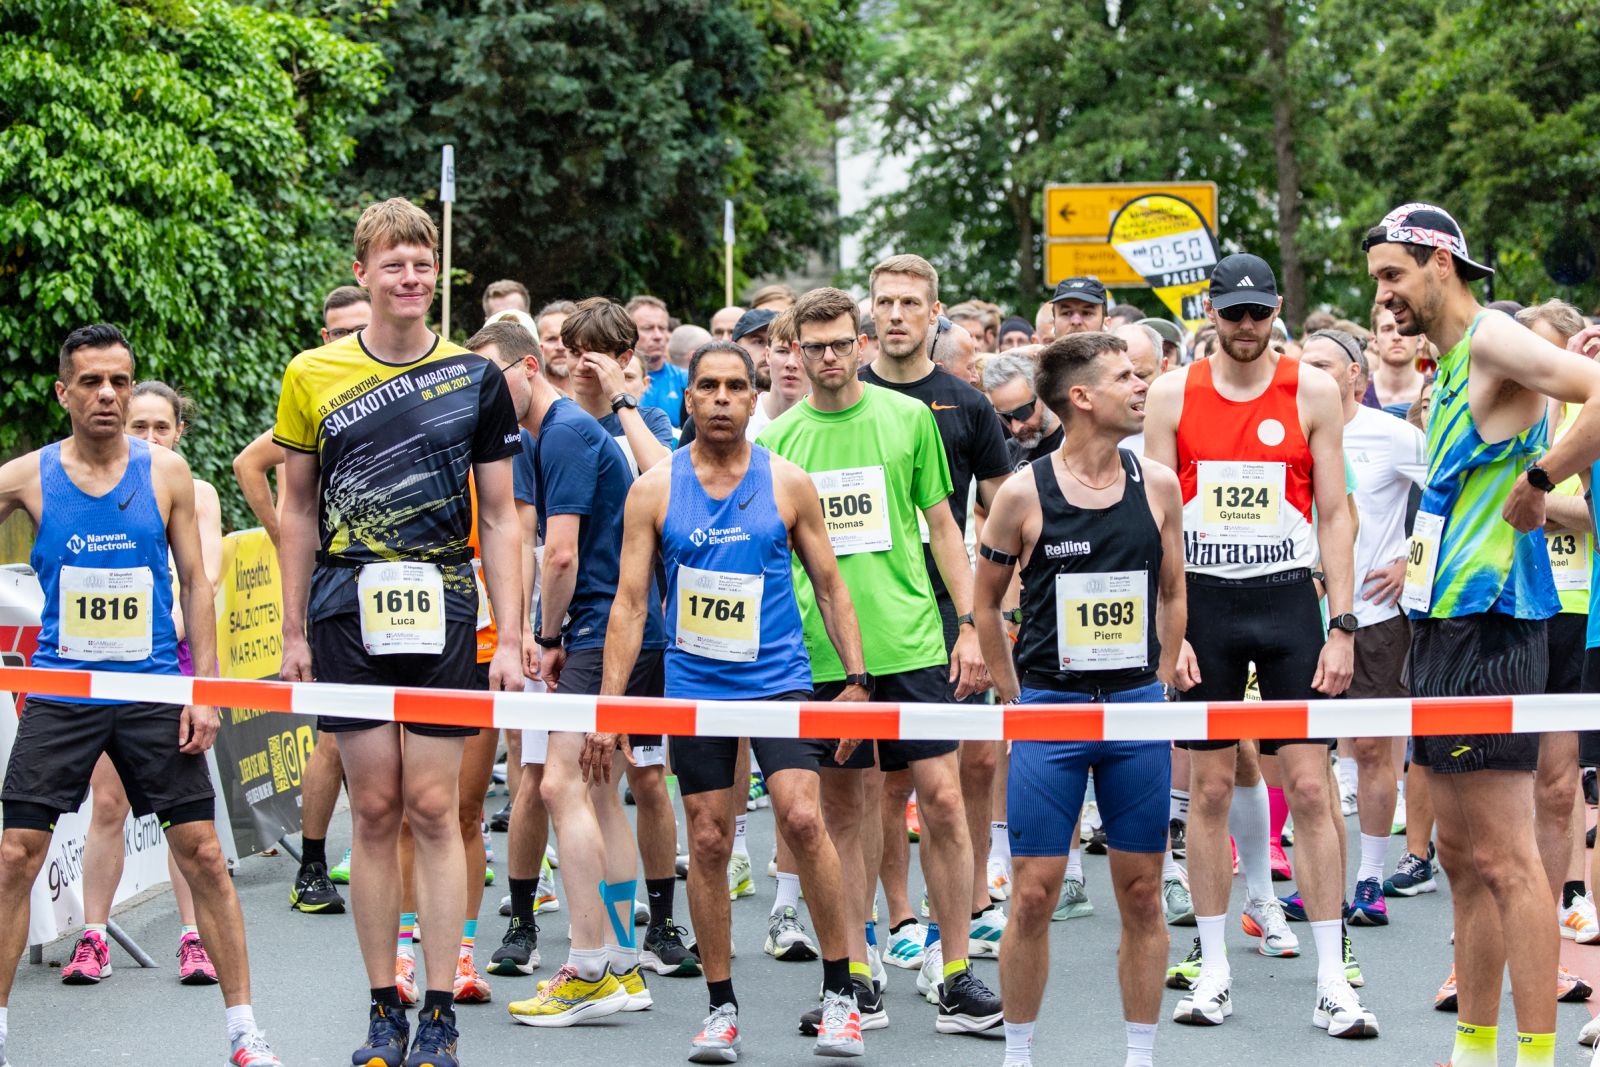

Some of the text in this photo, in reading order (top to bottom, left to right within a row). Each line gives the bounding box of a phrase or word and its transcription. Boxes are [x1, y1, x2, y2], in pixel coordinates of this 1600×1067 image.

[1150, 237, 1202, 269] 0:50
[1162, 267, 1207, 287] PACER
[317, 373, 382, 418] 13. KLINGENTHAL
[421, 375, 472, 401] 06. JUNI 2021
[324, 363, 467, 437] SALZKOTTEN MARATHON
[820, 493, 872, 518] 1506
[1213, 486, 1269, 508] 1324
[826, 520, 864, 530] Thomas
[1219, 511, 1261, 521] Gytautas
[86, 533, 127, 543] Narwan
[708, 526, 742, 536] Narwan
[708, 533, 751, 545] Electronic
[87, 540, 137, 552] Electronic
[1044, 541, 1091, 556] Reiling
[1407, 540, 1424, 566] 90
[1544, 535, 1576, 555] 43
[1551, 559, 1569, 567] hael
[76, 596, 138, 621] 1816
[373, 589, 431, 613] 1616
[688, 595, 745, 623] 1764
[229, 602, 280, 634] SALZKOTTEN
[390, 617, 415, 626] Luca
[1076, 601, 1134, 627] 1693
[1094, 631, 1122, 641] Pierre
[230, 634, 283, 667] MARATHON
[1457, 1025, 1476, 1034] ep
